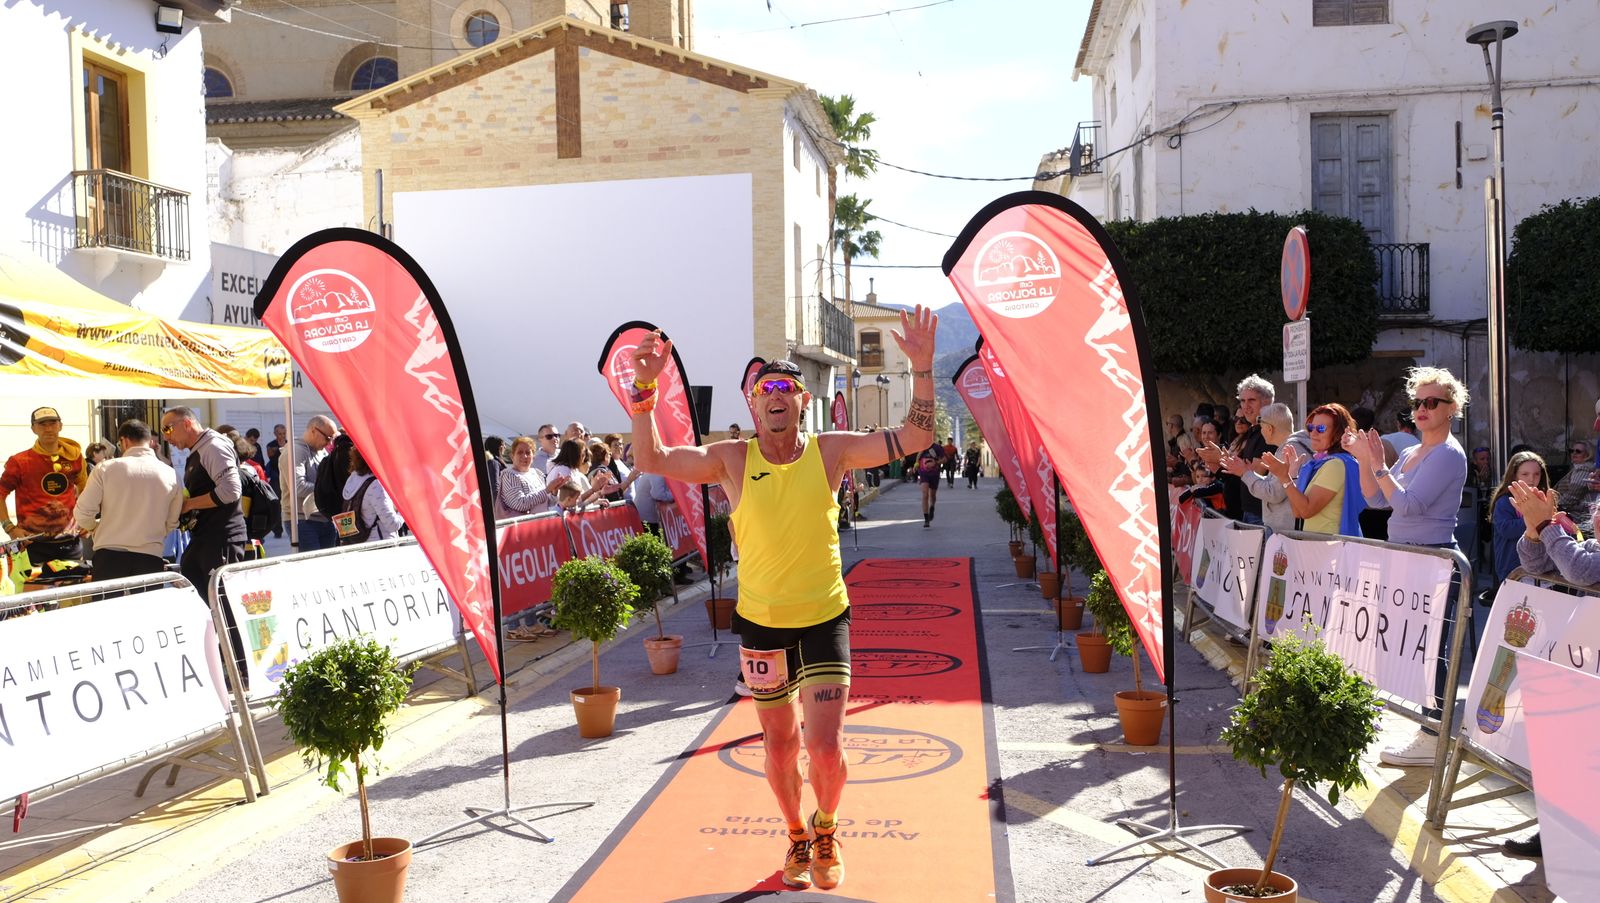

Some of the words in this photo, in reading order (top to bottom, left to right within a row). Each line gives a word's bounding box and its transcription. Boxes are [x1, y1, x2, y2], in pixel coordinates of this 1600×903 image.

[223, 303, 264, 327] AYUN
[499, 544, 560, 589] VEOLIA
[1411, 591, 1431, 614] DE
[296, 587, 449, 650] CANTORIA
[1285, 591, 1428, 664] CANTORIA
[2, 635, 145, 688] AMIENTO
[155, 626, 186, 649] DE
[746, 660, 769, 675] 10
[814, 687, 843, 703] WILD
[725, 815, 855, 827] Coria
[865, 818, 903, 828] de
[699, 826, 921, 841] Ayuniento
